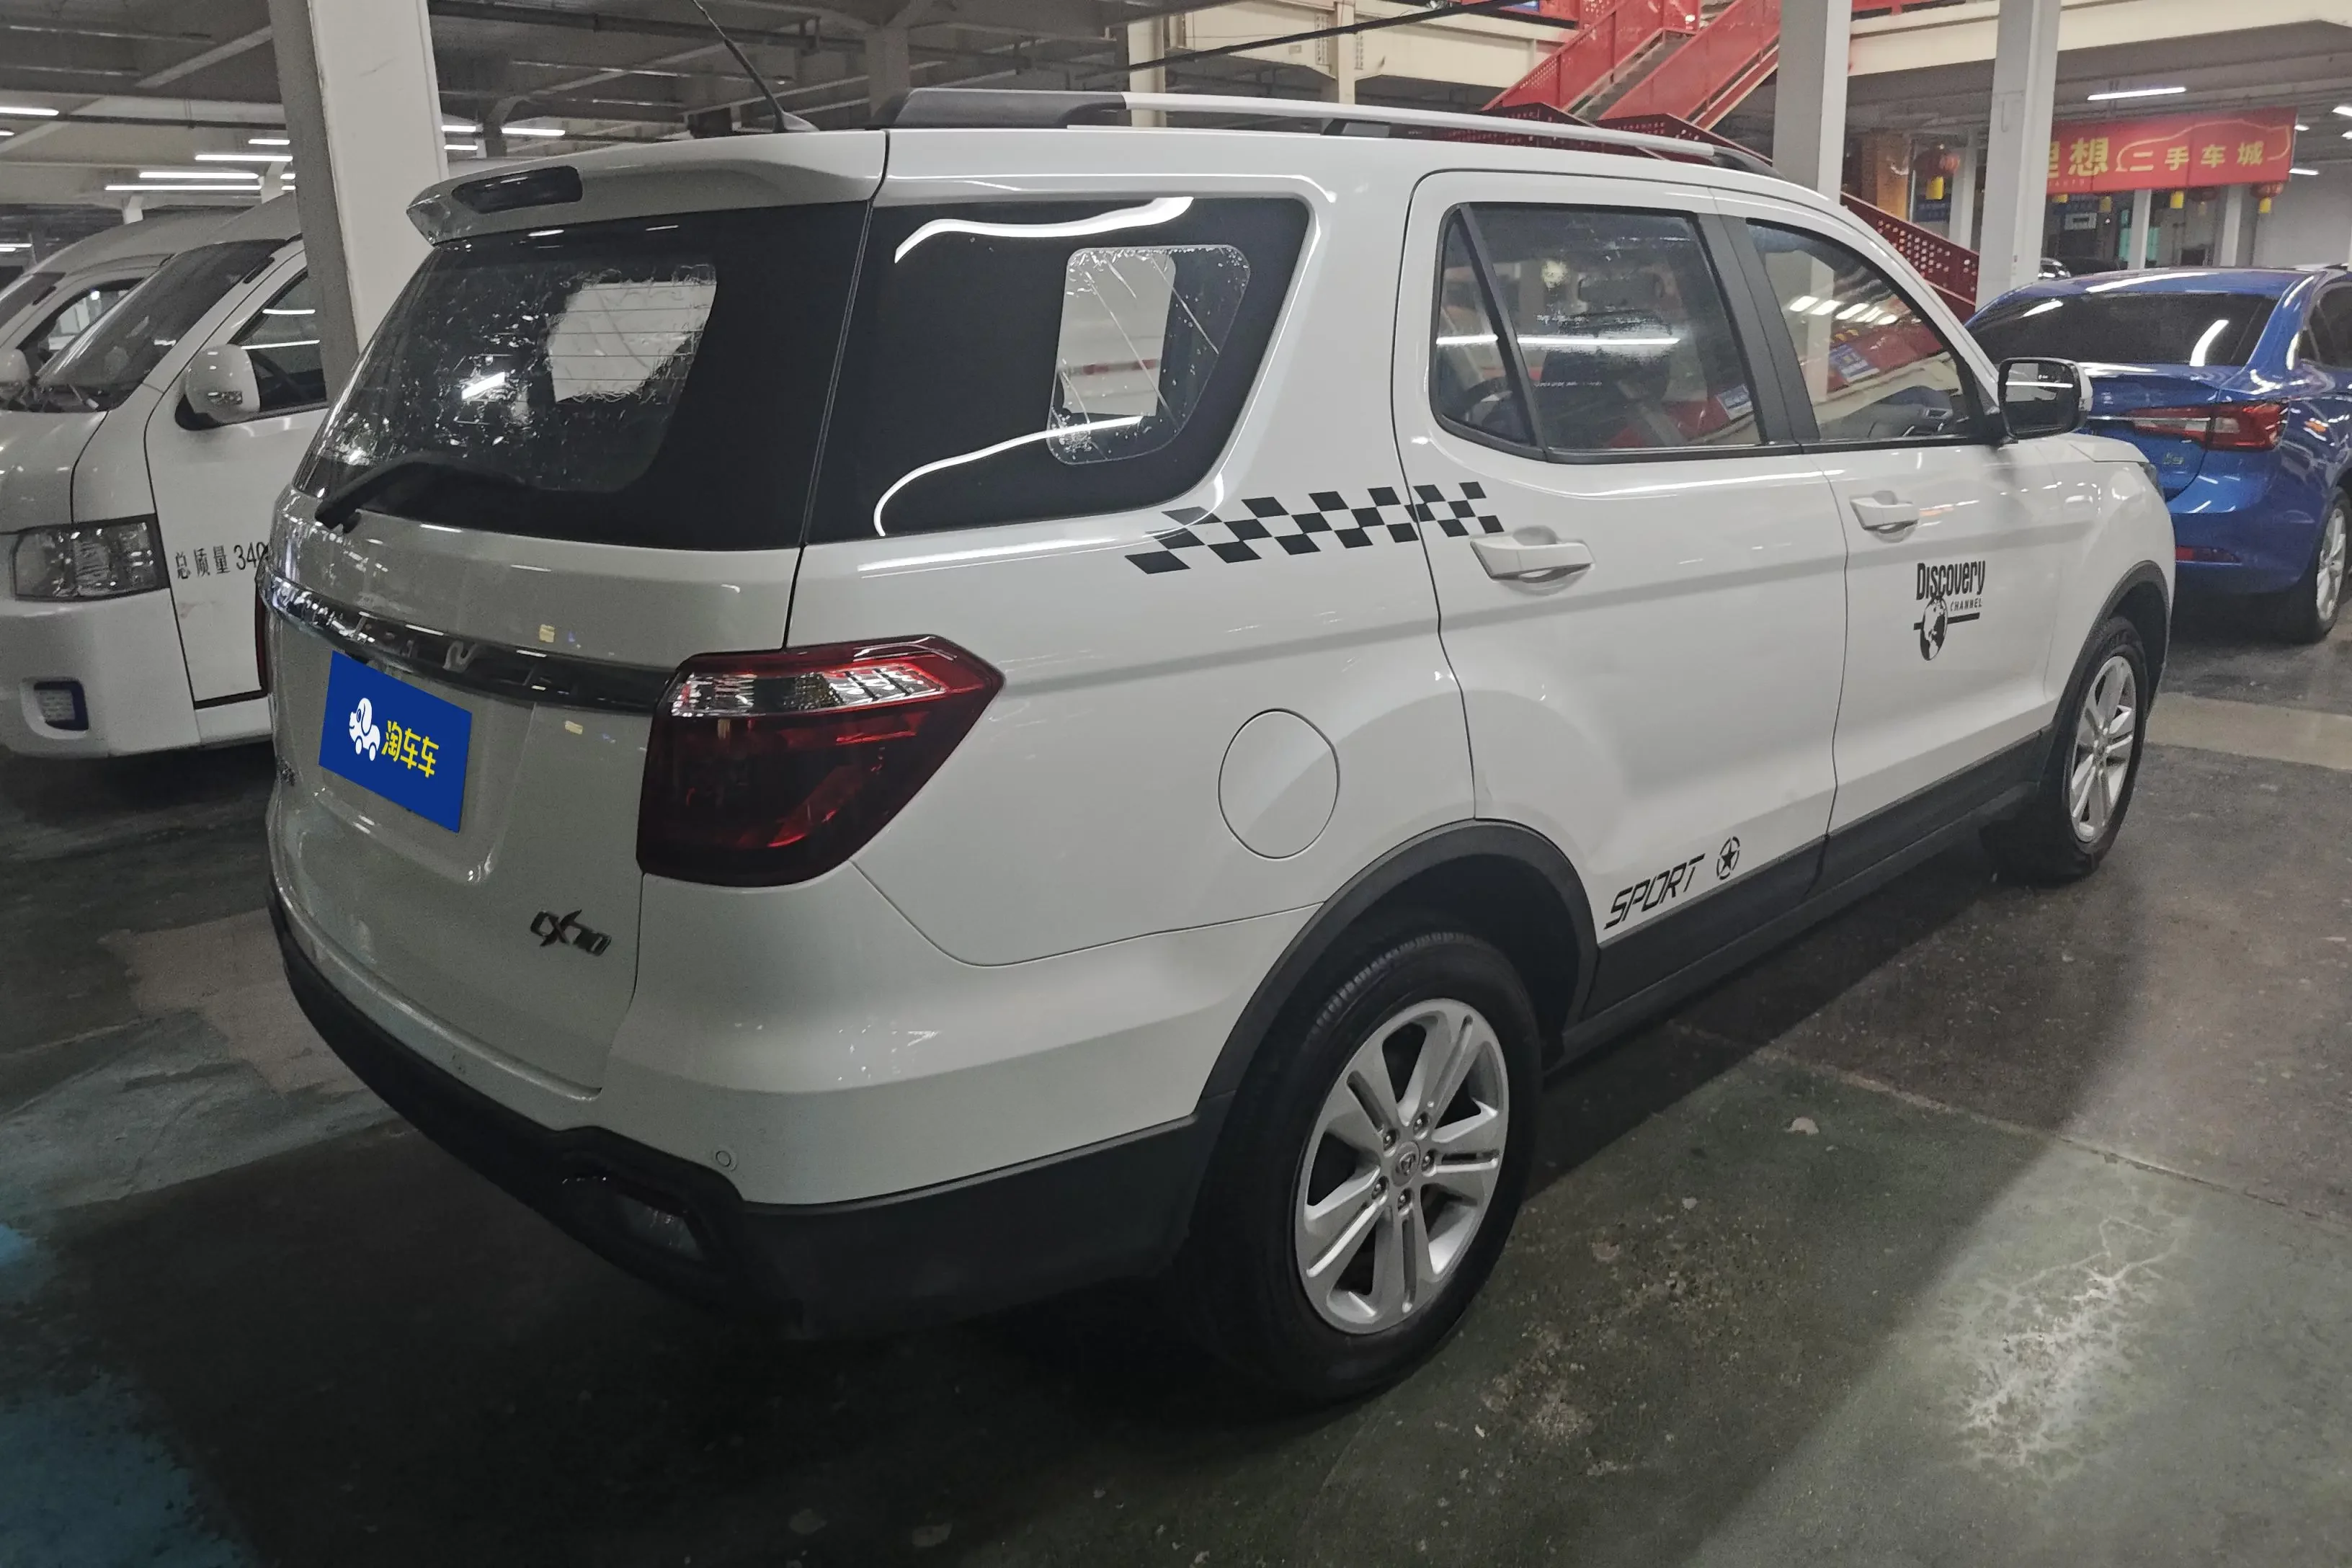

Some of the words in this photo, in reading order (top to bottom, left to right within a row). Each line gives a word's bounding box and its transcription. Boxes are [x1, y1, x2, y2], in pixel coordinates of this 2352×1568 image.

[2129, 141, 2265, 172] 二手车城
[1916, 561, 1986, 601] Discovery
[1950, 597, 1982, 612] CHANNEL
[1603, 853, 1706, 930] SPORT
